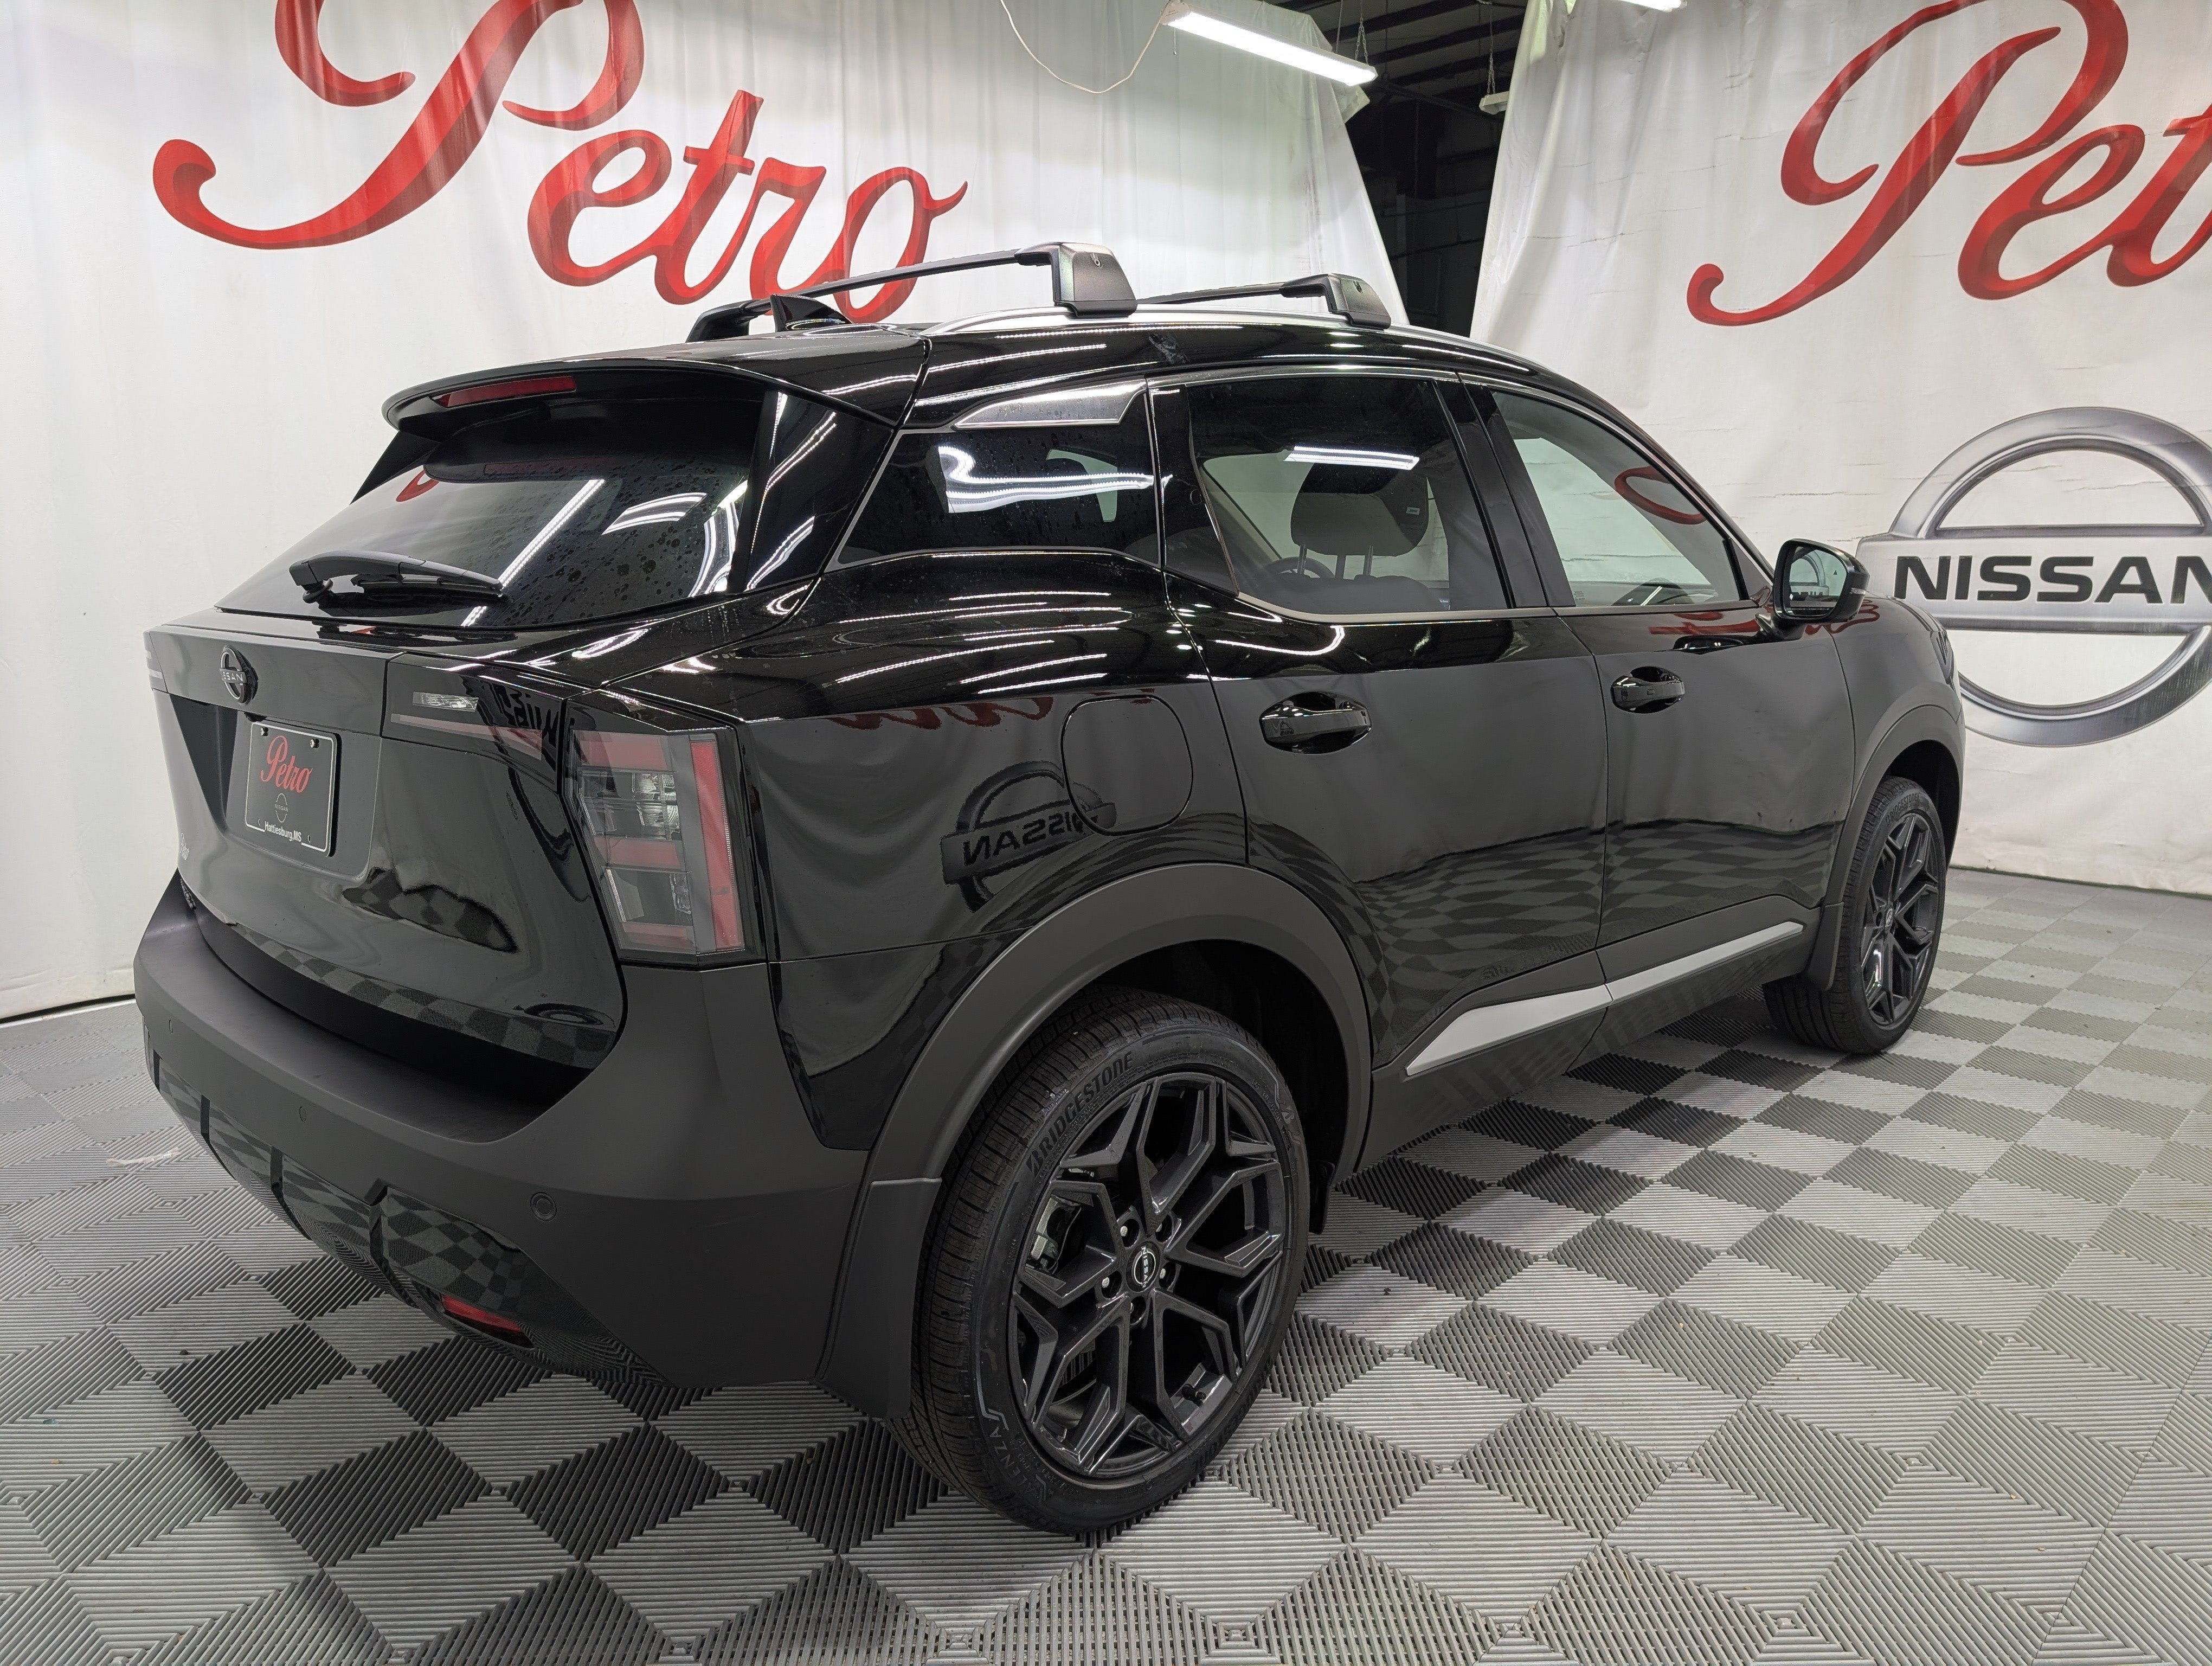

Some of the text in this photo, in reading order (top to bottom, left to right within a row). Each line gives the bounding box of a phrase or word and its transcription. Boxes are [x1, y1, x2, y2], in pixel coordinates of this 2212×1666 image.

[153, 0, 968, 324] Petro
[1894, 555, 2212, 604] NISSAN
[260, 735, 313, 793] Petro
[274, 804, 288, 812] NISSAN
[1026, 1050, 1134, 1179] BRIDGESTONE
[1140, 1245, 1149, 1289] NISSAN
